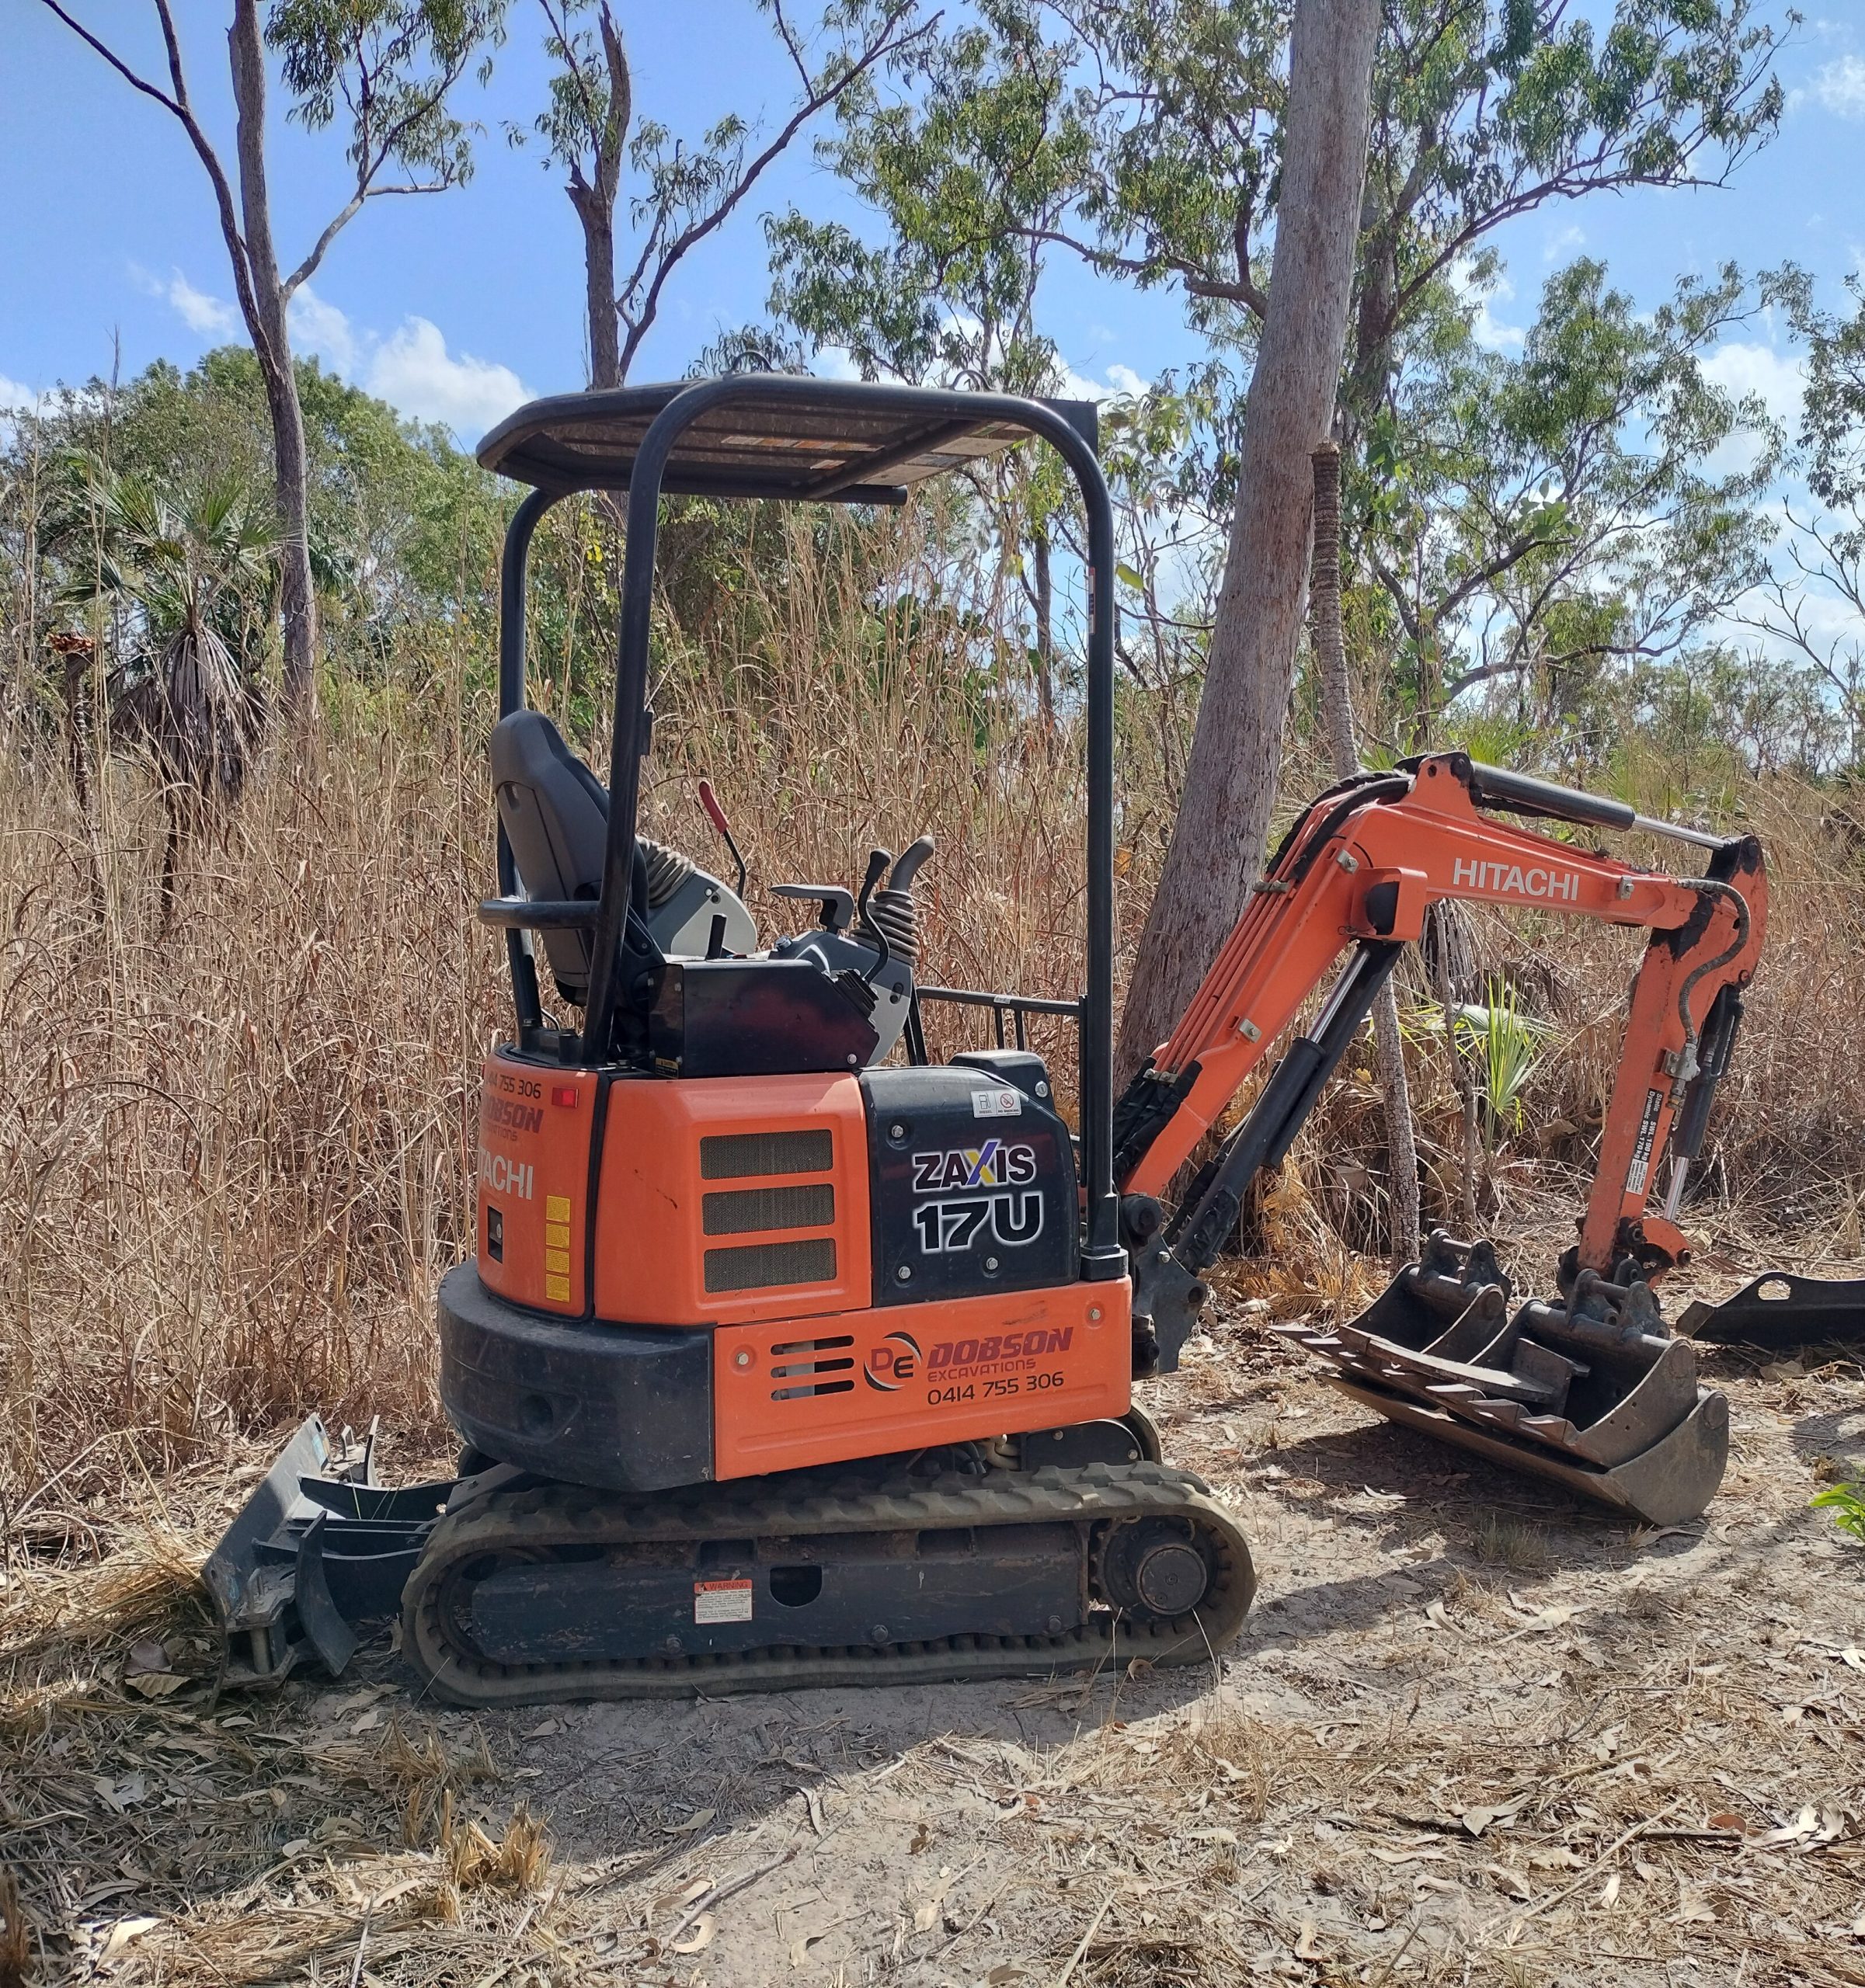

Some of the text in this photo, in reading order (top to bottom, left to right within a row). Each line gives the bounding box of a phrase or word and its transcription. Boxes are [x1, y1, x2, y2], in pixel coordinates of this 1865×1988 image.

[1453, 857, 1579, 902] HITACHI
[499, 1073, 516, 1093] 755
[517, 1079, 542, 1100] 306
[1653, 1093, 1663, 1112] Static
[482, 1092, 545, 1134] OBSON
[1644, 1090, 1655, 1119] Dynamic
[1637, 1136, 1645, 1150] 170
[912, 1138, 1036, 1193] ZAXIS
[912, 1190, 1044, 1254] 17U
[927, 1326, 1074, 1369] DOBSON
[927, 1357, 1037, 1382] EXCAVATIONS
[927, 1371, 1065, 1406] 0414 755 306
[709, 1581, 748, 1591] WARNING
